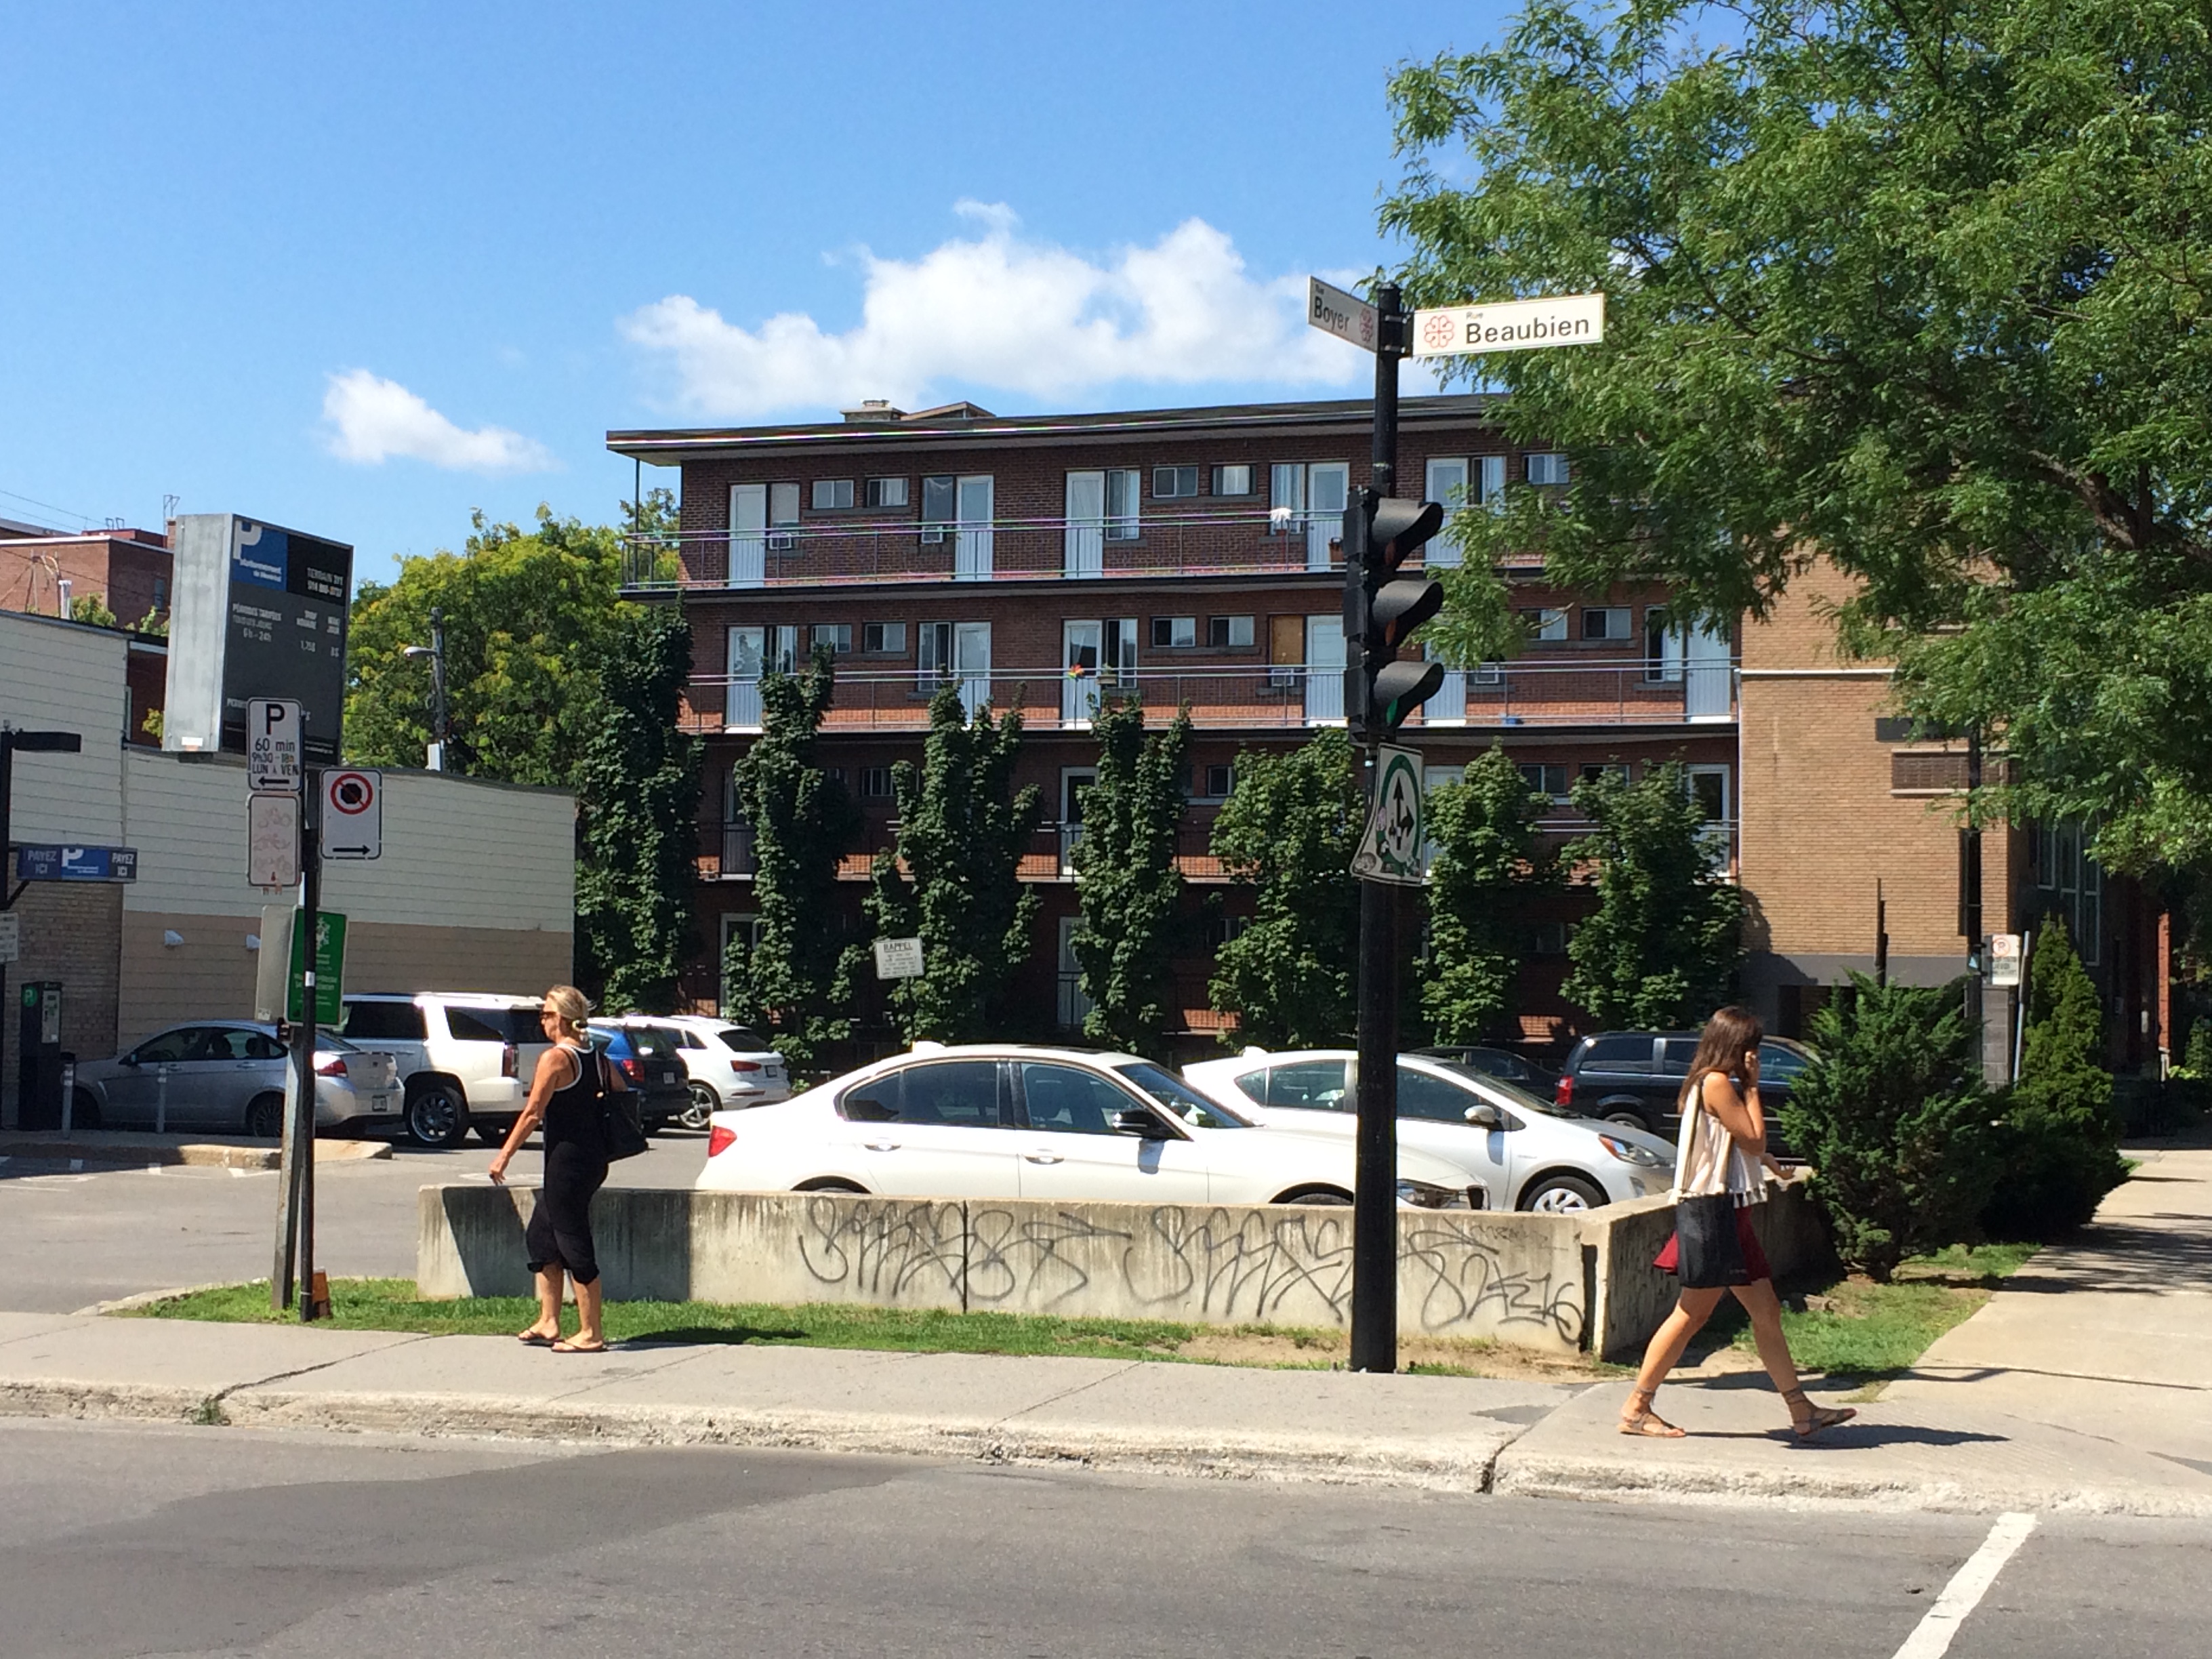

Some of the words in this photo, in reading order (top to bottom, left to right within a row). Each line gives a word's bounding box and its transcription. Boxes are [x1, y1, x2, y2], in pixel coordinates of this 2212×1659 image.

[1315, 295, 1351, 332] Boyer
[1465, 311, 1483, 320] Rue
[1465, 315, 1590, 344] Beaubien
[266, 703, 285, 735] P
[255, 737, 270, 752] 60
[275, 739, 295, 752] min
[251, 752, 273, 763] 9h30
[251, 764, 269, 775] LUN
[281, 764, 300, 776] VEN
[27, 850, 57, 862] PAYEZ
[112, 852, 135, 865] PAYEZ
[35, 863, 48, 874] ICI
[117, 865, 128, 877] ICI
[24, 989, 33, 1004] P
